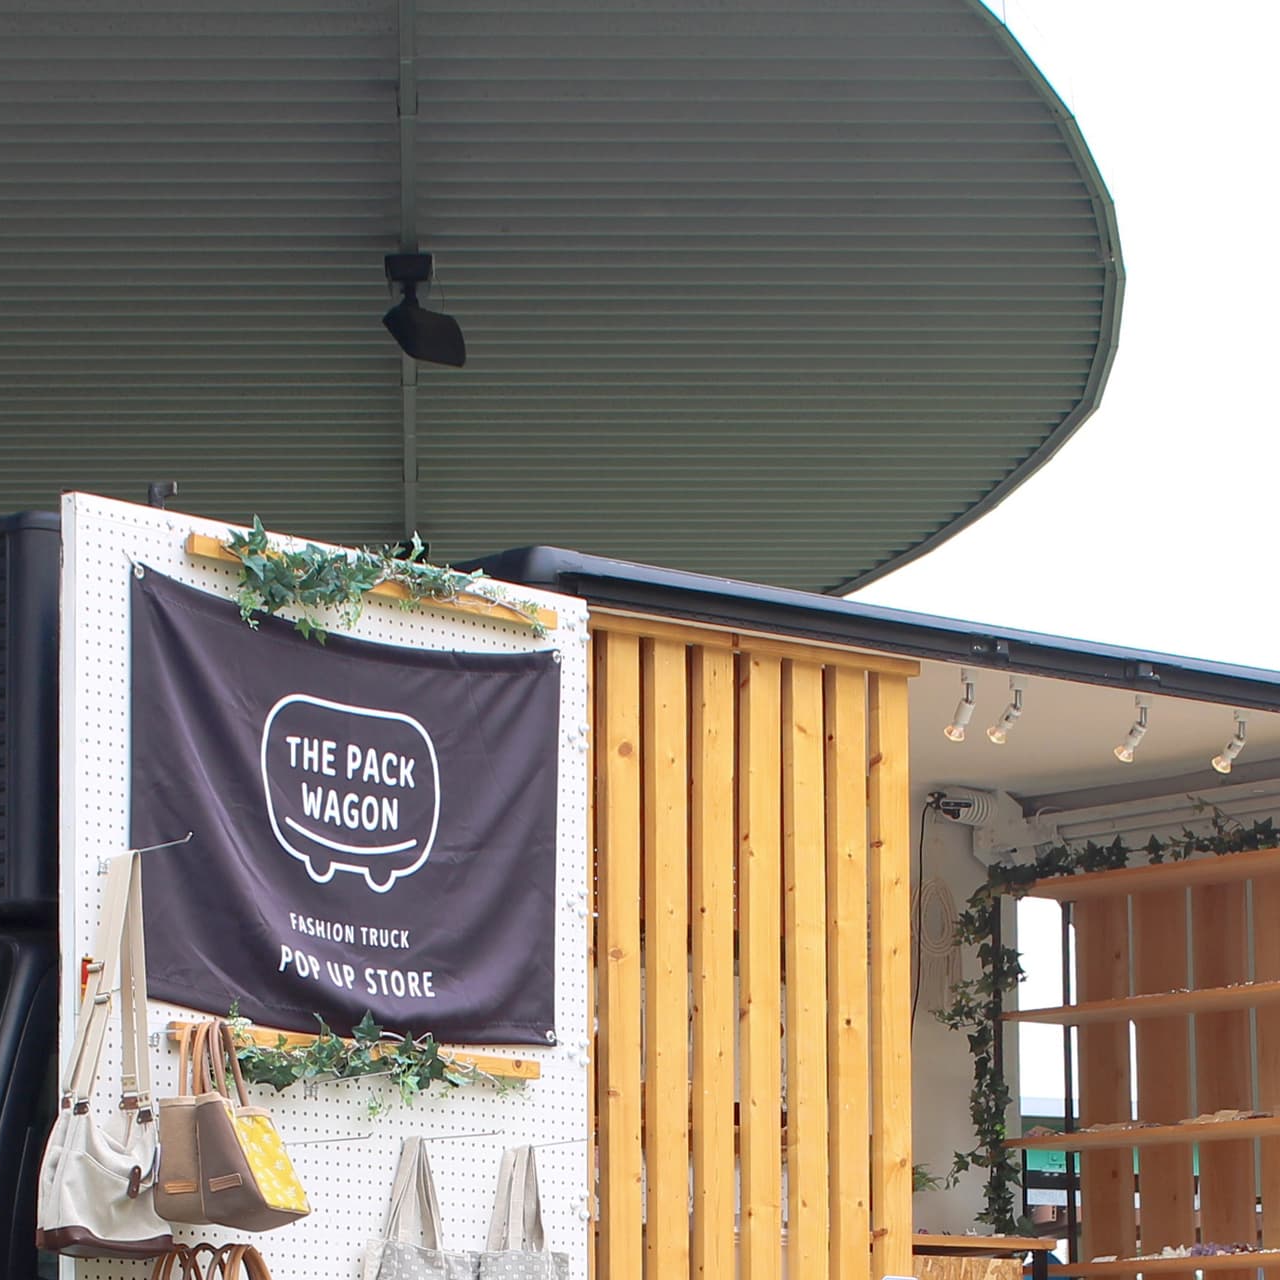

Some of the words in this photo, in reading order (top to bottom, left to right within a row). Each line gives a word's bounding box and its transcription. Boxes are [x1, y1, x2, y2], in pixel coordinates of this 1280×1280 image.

[285, 735, 337, 777] THE
[346, 744, 415, 789] PACK
[301, 782, 399, 831] WAGON
[289, 912, 355, 944] FASHION
[360, 926, 410, 949] TRUCK
[278, 944, 321, 980] POP
[325, 960, 356, 991] UP
[365, 967, 436, 999] STORE
